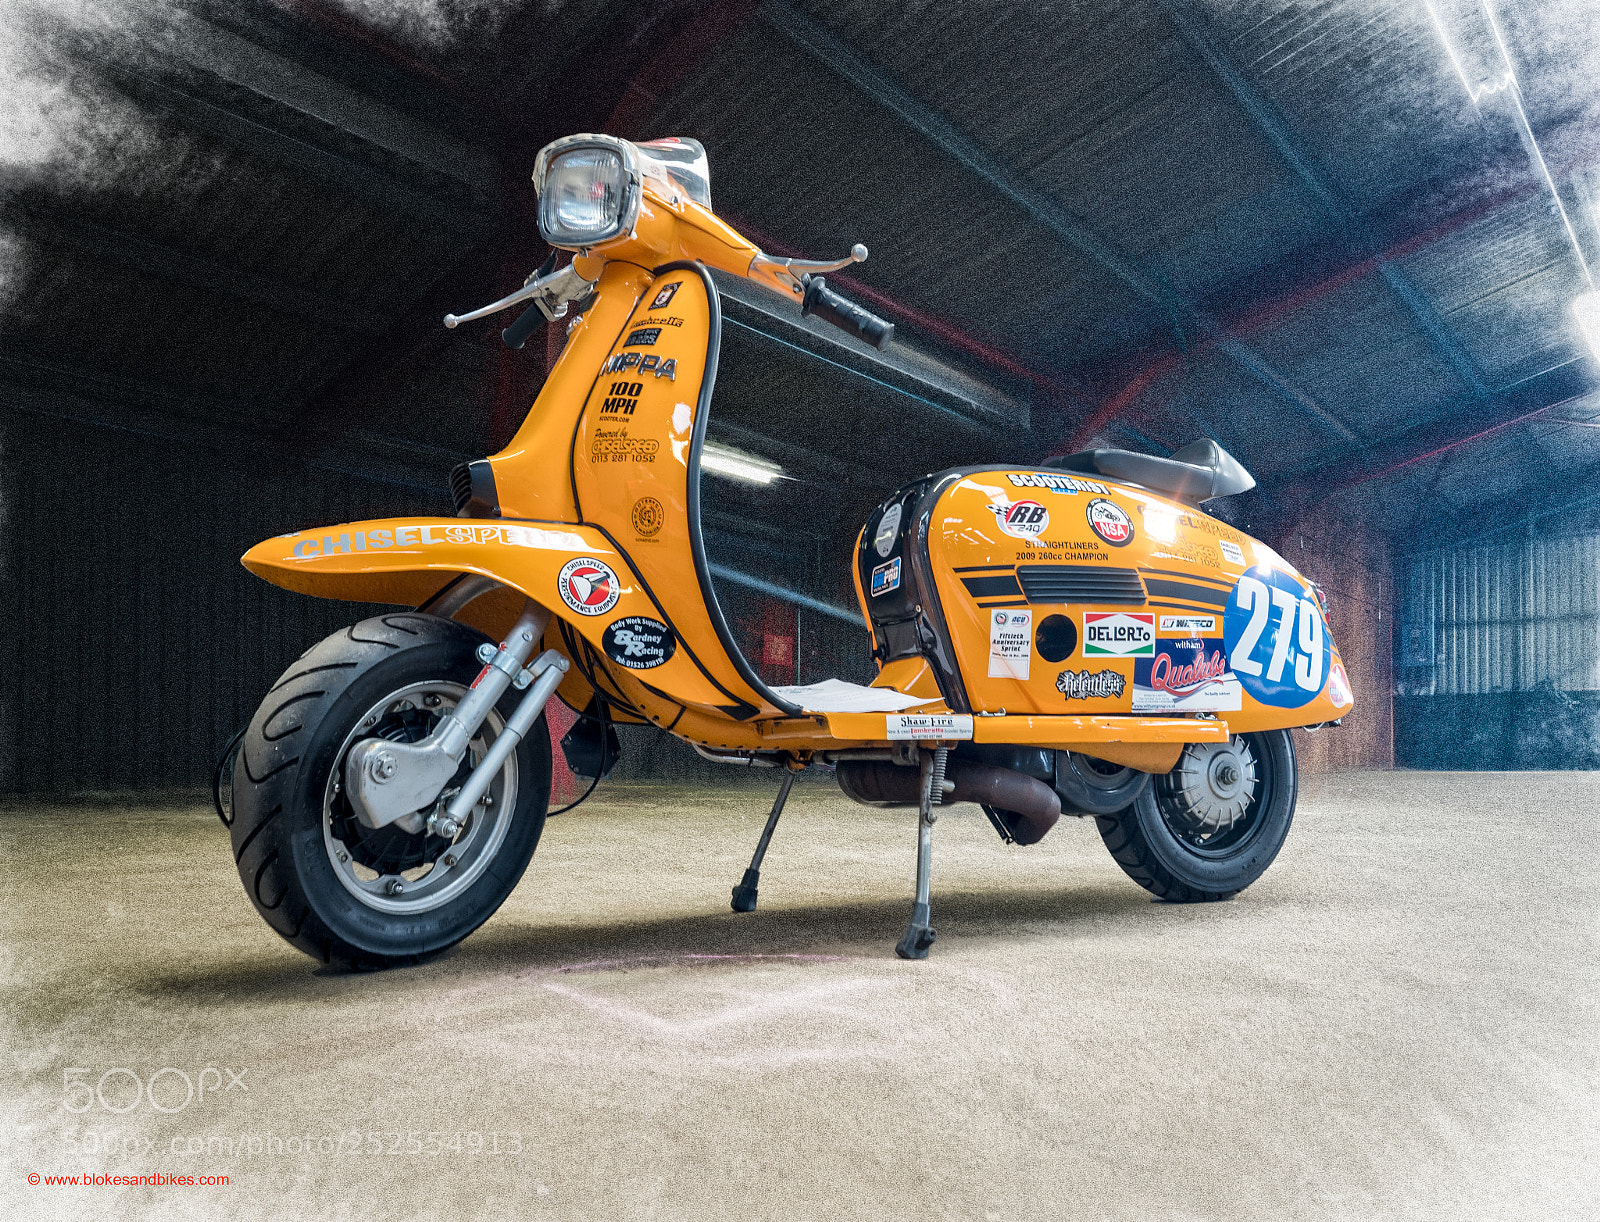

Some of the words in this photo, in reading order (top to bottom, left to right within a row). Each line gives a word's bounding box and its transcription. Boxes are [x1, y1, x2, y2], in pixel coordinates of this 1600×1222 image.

[609, 382, 643, 396] 100
[600, 398, 638, 415] MPH
[612, 455, 627, 463] 281
[632, 455, 656, 463] 1052
[1006, 474, 1112, 495] SCOOTERIST
[1009, 506, 1047, 523] RB
[1018, 525, 1040, 533] 240
[1100, 523, 1126, 537] NSA
[1025, 540, 1099, 550] STRAIGHTLINERS
[1016, 552, 1036, 561] 2009
[1039, 552, 1062, 561] 260cc
[1065, 552, 1109, 561] CHAMPION
[610, 620, 625, 631] Body
[626, 617, 641, 625] Work
[642, 618, 667, 633] Supplied
[614, 629, 662, 645] Bardney
[1088, 626, 1151, 642] DELLORTO
[1230, 576, 1323, 692] 279
[624, 641, 664, 657] Racing
[1175, 641, 1201, 649] witham
[1151, 650, 1226, 691] Qualube
